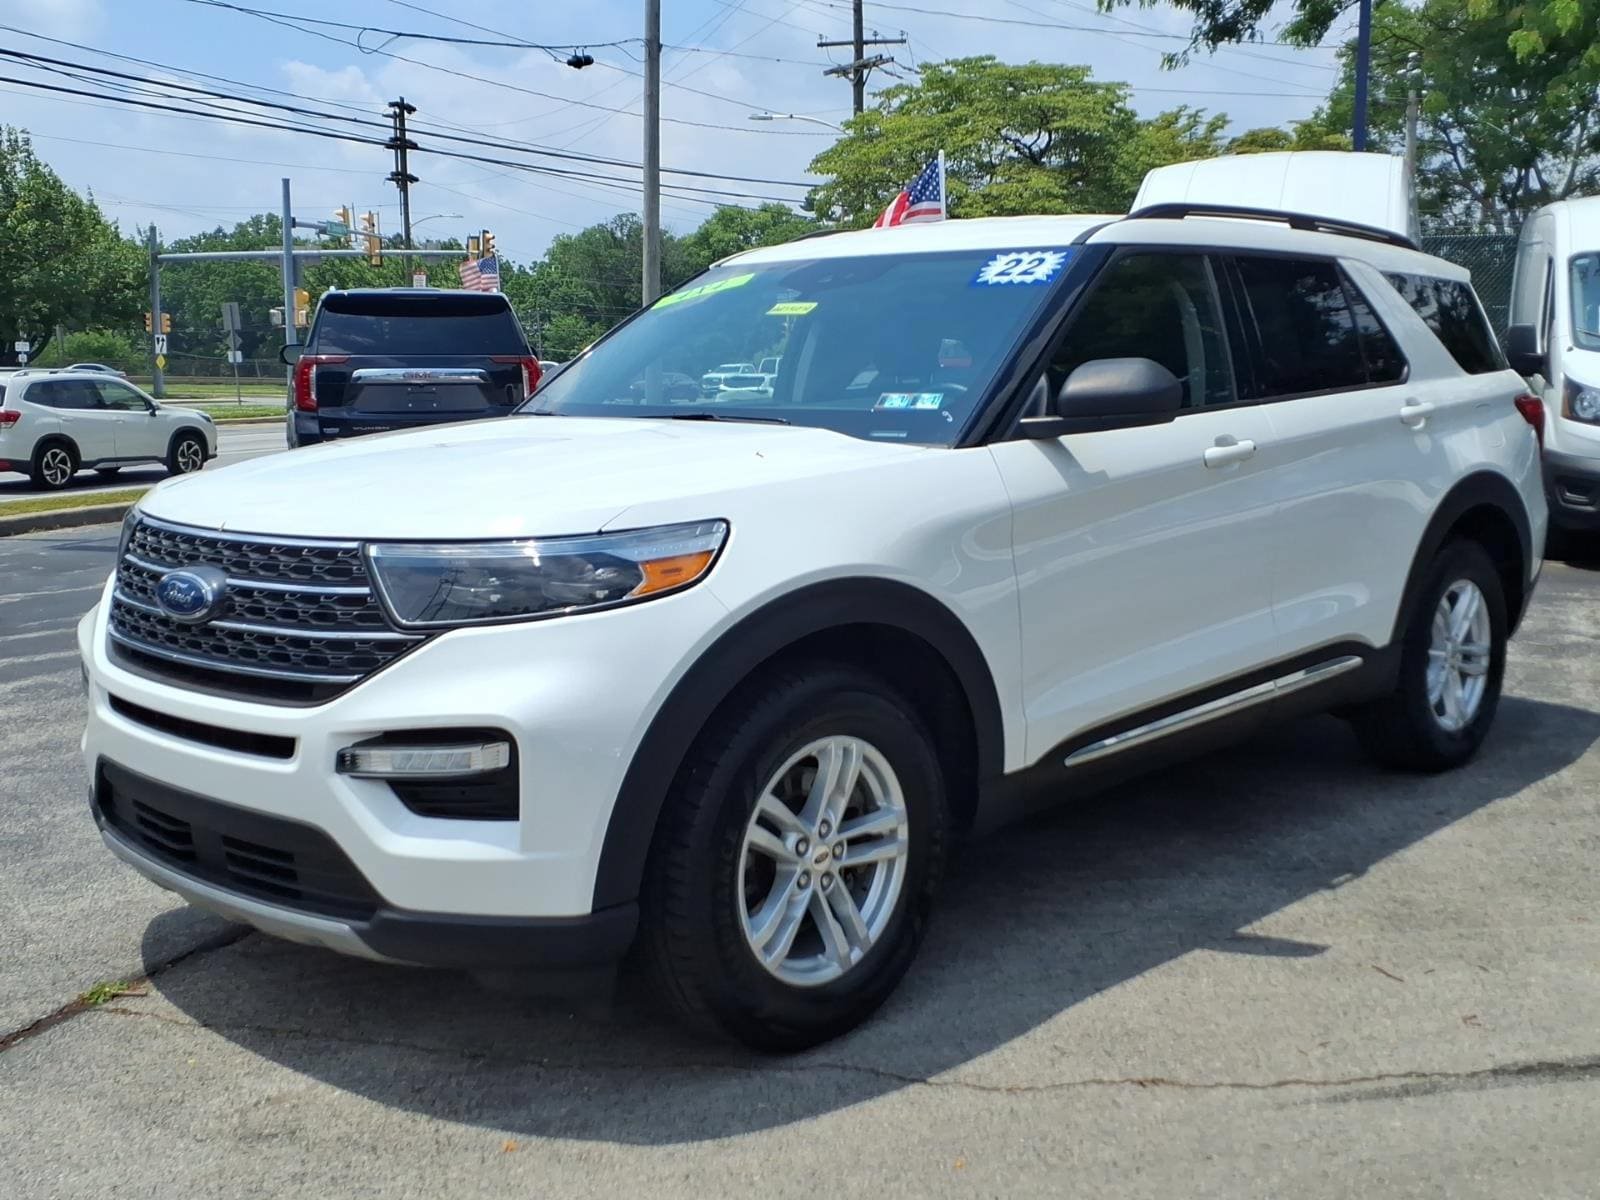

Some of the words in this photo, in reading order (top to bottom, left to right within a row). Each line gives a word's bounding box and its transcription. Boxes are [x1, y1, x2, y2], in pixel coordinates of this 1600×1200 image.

[994, 257, 1046, 277] 22
[402, 371, 432, 380] GMC
[164, 579, 196, 604] Ford
